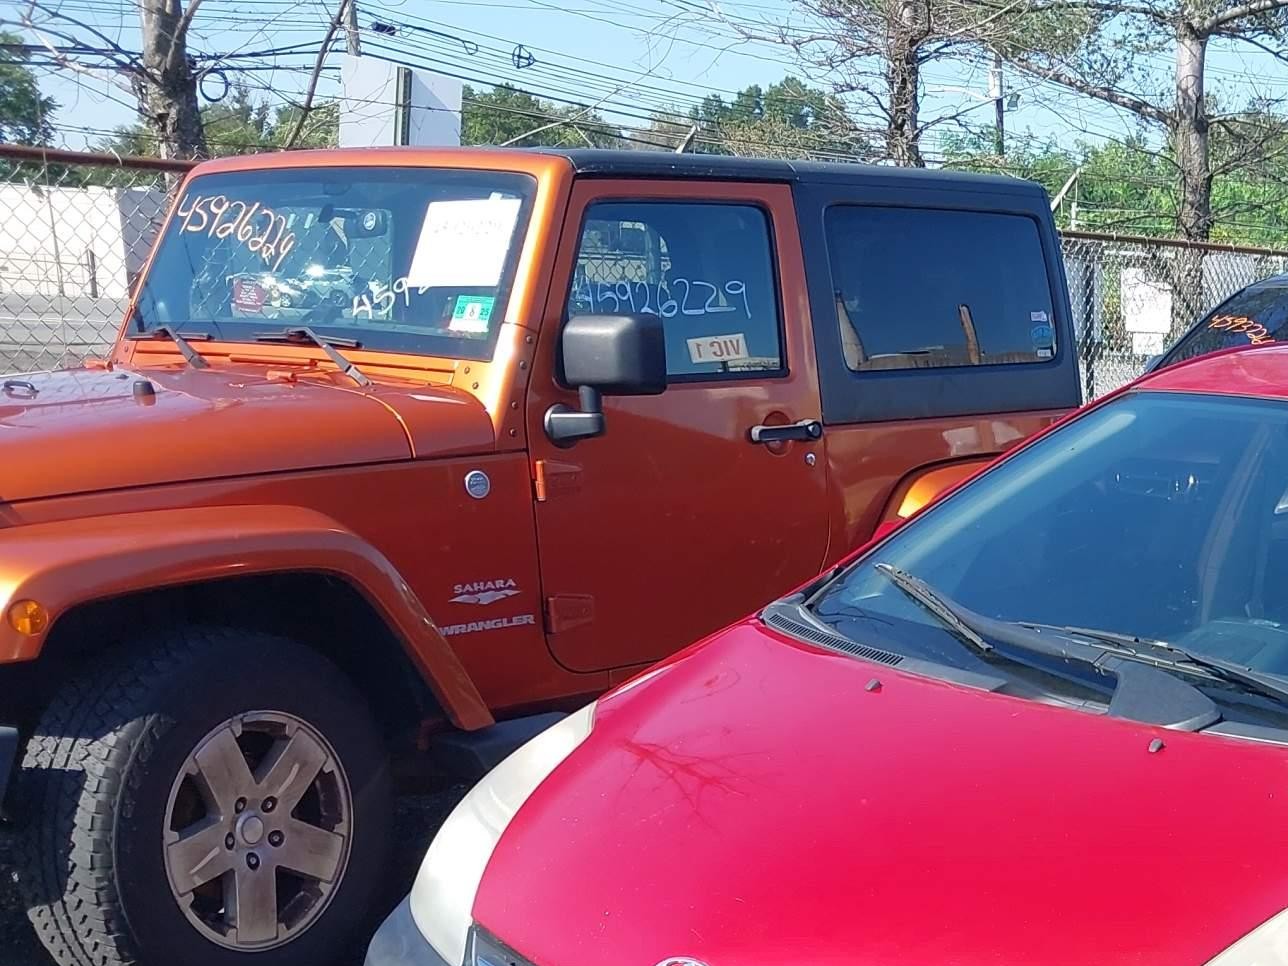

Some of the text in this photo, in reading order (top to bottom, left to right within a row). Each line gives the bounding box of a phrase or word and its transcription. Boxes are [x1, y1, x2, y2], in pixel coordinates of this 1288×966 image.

[177, 193, 296, 273] 45926229
[454, 579, 517, 593] SAHARA
[439, 614, 536, 636] WRANGLER
